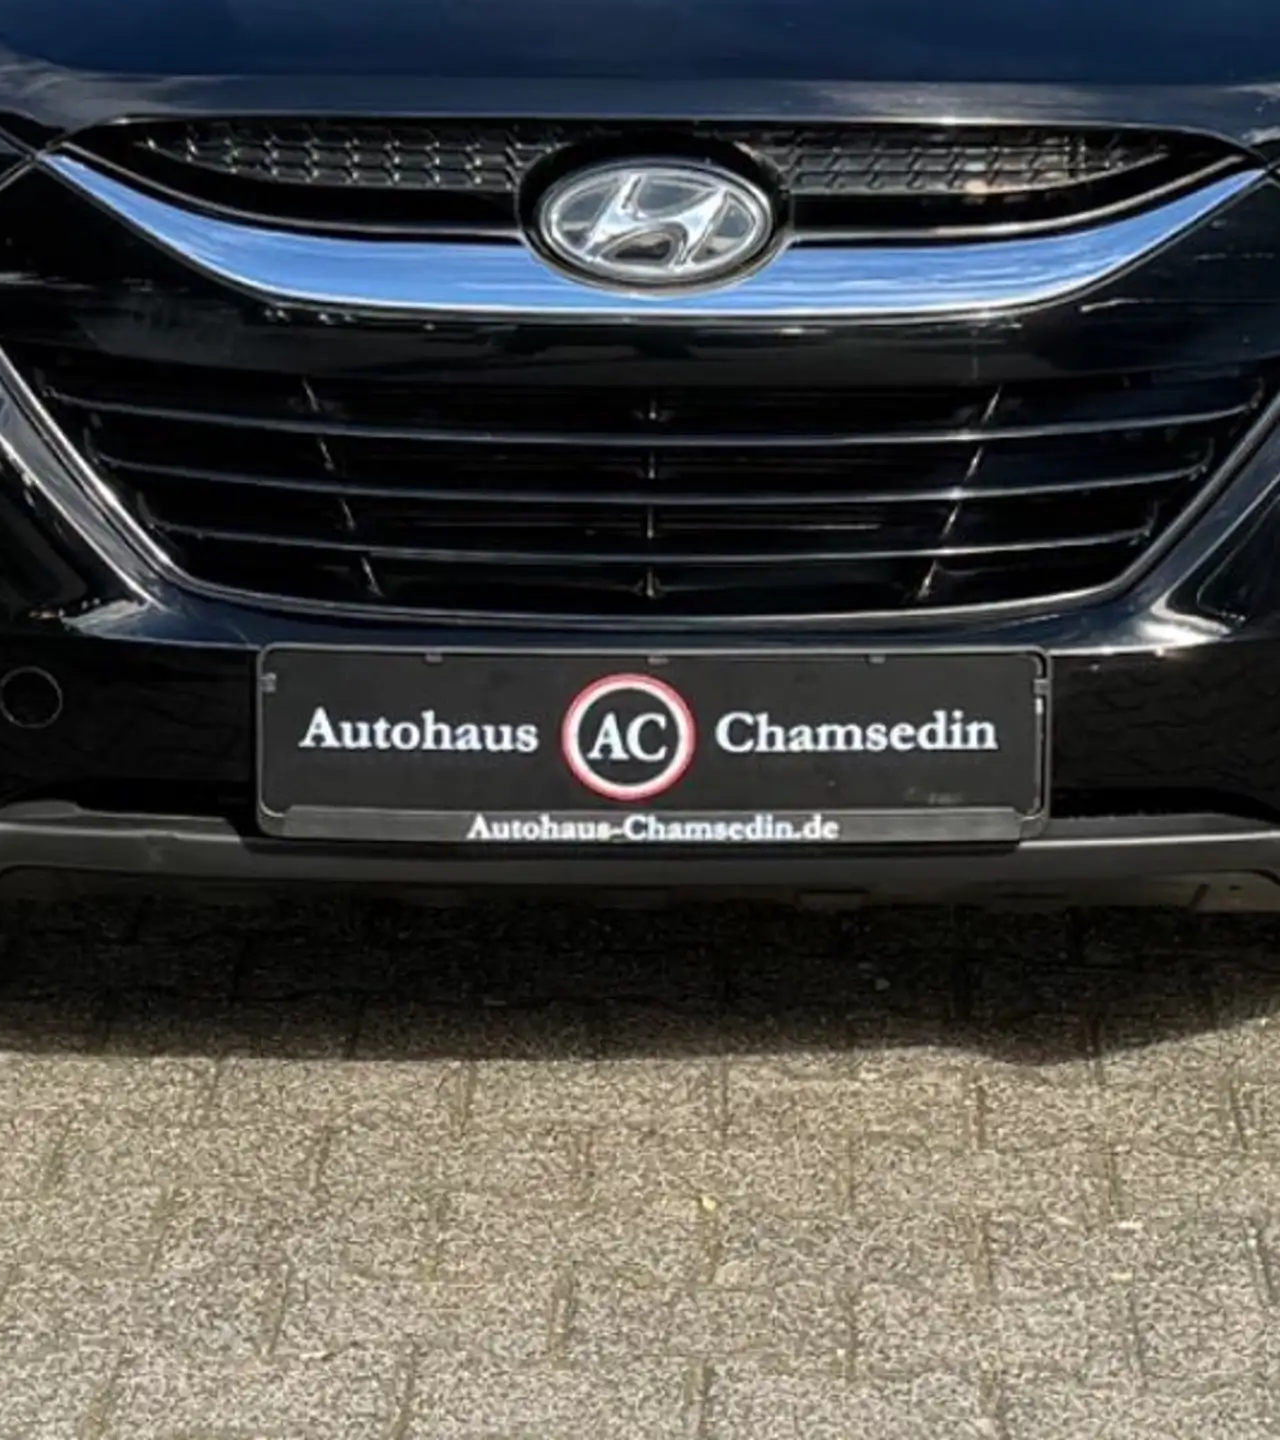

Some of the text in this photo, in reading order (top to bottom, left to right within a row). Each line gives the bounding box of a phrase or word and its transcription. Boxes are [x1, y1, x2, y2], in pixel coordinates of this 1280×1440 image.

[298, 706, 998, 762] Autohaus AC Chamsedin
[465, 812, 840, 842] Autohaus-Chamsedin.de
